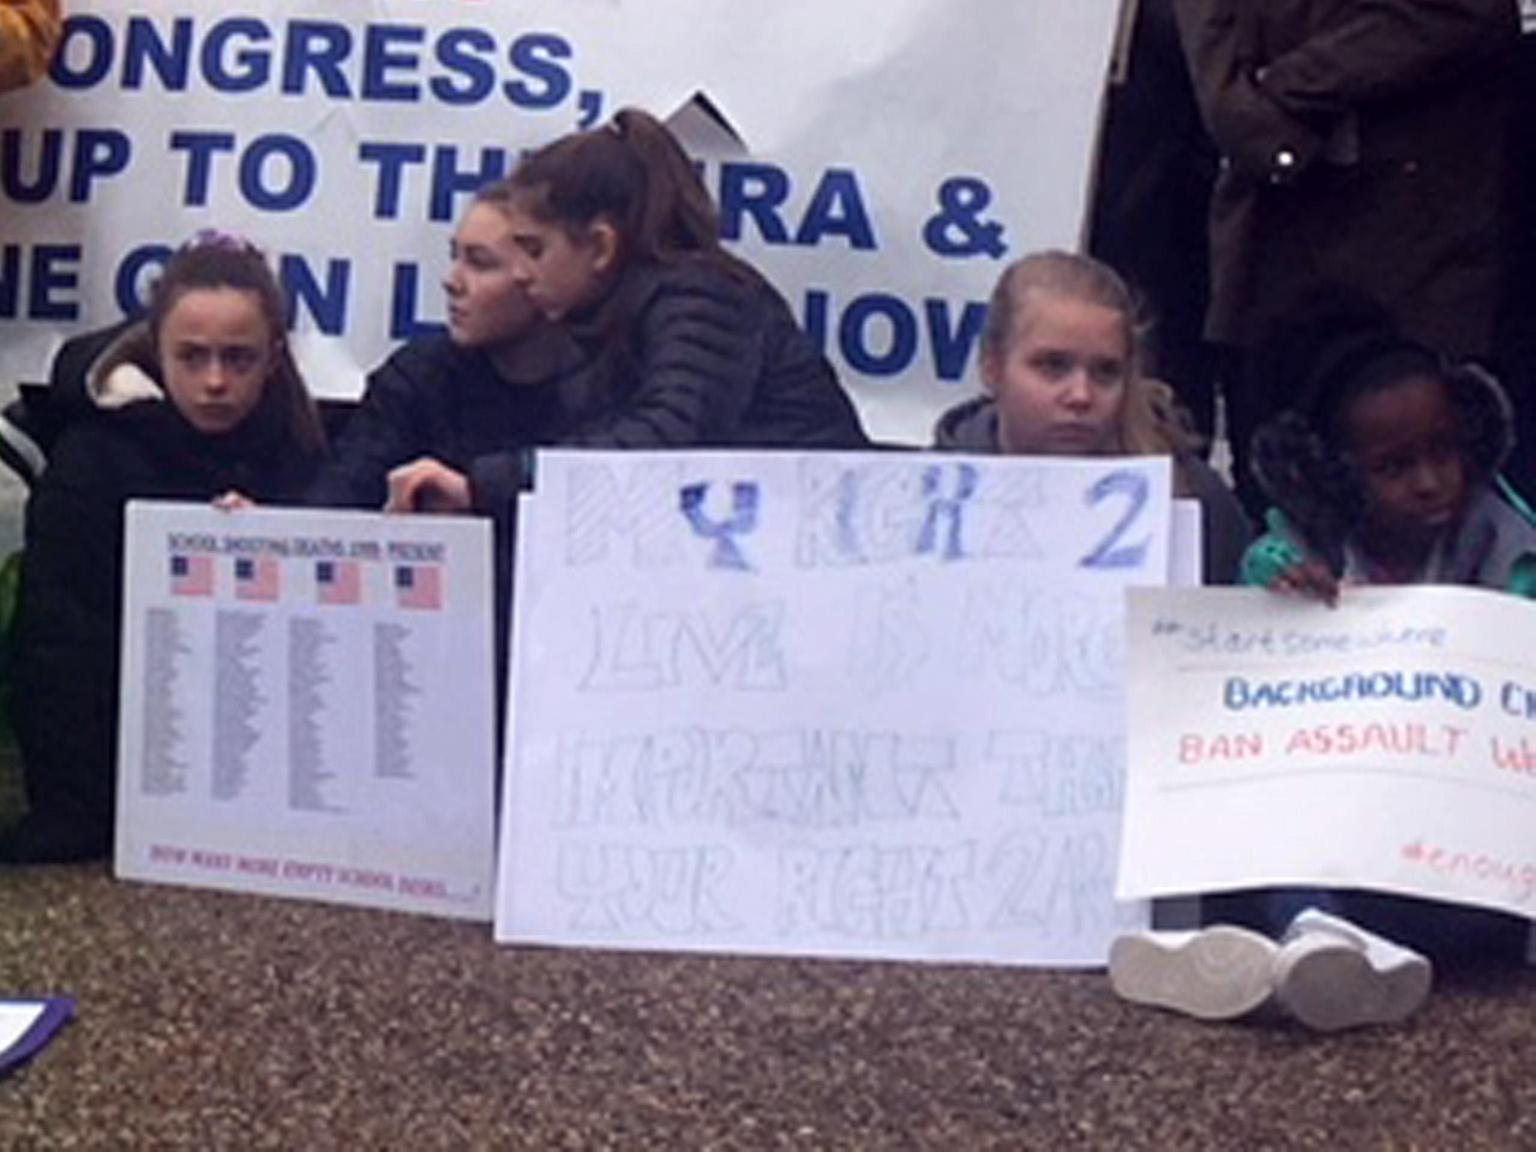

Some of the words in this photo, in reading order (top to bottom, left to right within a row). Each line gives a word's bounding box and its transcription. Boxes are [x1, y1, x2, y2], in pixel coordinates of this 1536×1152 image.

[44, 13, 605, 129] ONGRESS,
[0, 127, 133, 206] UP
[169, 130, 319, 212] TO
[357, 142, 509, 224] TH
[690, 159, 878, 252] RA
[920, 176, 1010, 261] &
[1076, 466, 1155, 572] 2
[1223, 669, 1482, 711] BACKGROUND
[1178, 731, 1263, 766] BAN
[1284, 721, 1468, 760] ASSAULT
